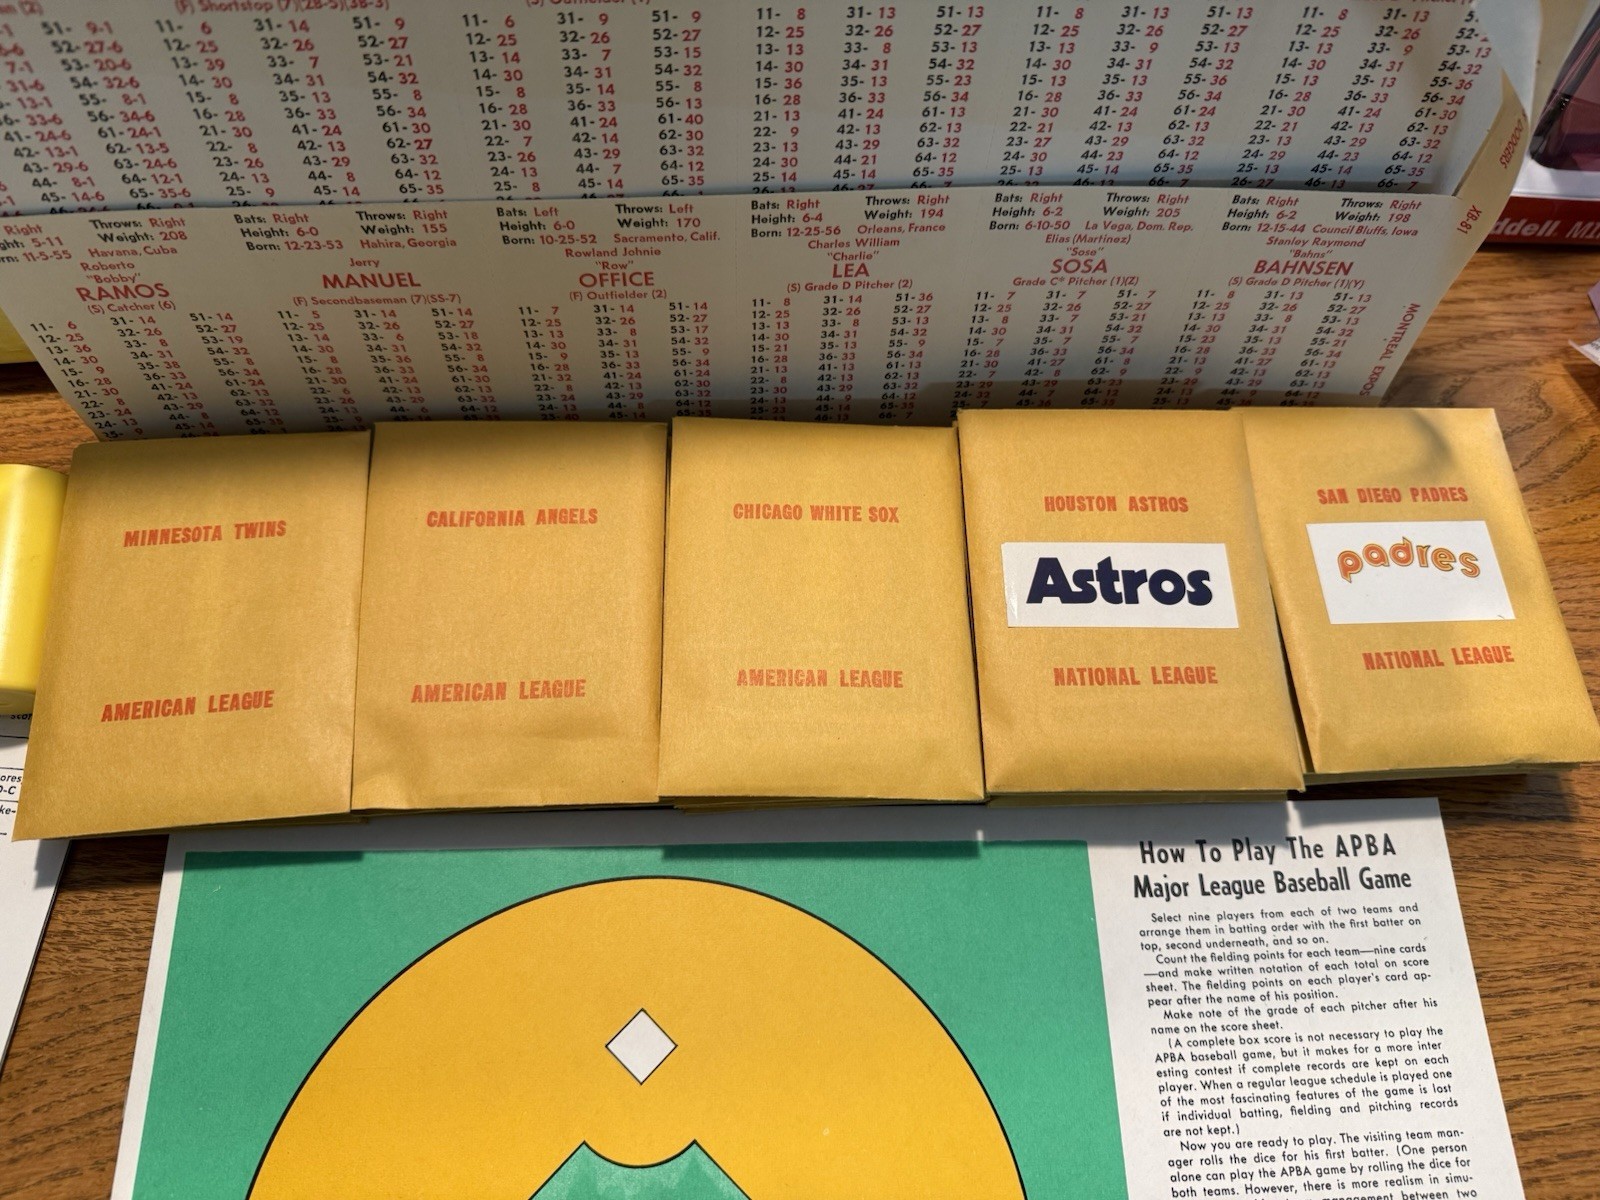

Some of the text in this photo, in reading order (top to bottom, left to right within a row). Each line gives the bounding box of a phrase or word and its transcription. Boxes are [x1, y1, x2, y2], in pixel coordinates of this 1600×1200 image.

[1499, 118, 1524, 169] DODGERS
[496, 206, 559, 217] Bats: Left
[614, 203, 694, 214] Throws: Left
[992, 206, 1063, 218] Height: 6-2
[1103, 206, 1181, 218] Weight: 205
[857, 222, 946, 234] Orleans, France
[1085, 220, 1193, 233] La Vega, Dom. Rep.
[1312, 224, 1419, 236] Council Bluffs, Iowa
[1565, 221, 1600, 239] MI
[359, 237, 457, 249] Hahira, Georgia
[613, 231, 720, 243] Sacramento, Calif.
[808, 237, 900, 249] Charles William
[1045, 233, 1131, 245] Elias (Martinez)
[1266, 236, 1366, 248] Stanley Raymond
[88, 245, 178, 258] Havana, Cuba
[565, 247, 661, 258] Rowland Johnie
[80, 261, 135, 271] Roberto
[350, 257, 380, 268] Jerry
[832, 262, 870, 278] LEA
[1050, 258, 1107, 274] SOSA
[1253, 259, 1354, 276] BAHNSEN
[86, 272, 141, 284] "Bobby"
[322, 272, 421, 289] MANUEL
[579, 271, 654, 288] OFFICE
[75, 283, 170, 302] RAMOS
[293, 294, 461, 307] (F) Secondbaseman (7)(SS-7)
[569, 289, 667, 301] (F) Outfielder (2)
[87, 300, 176, 315] (S) Catcher (6)
[1359, 303, 1421, 396] MONTREAL EXPOS
[1044, 495, 1189, 513] HOUSTON ASTROS
[1316, 486, 1469, 505] SAN DIEGO PADRES
[426, 508, 598, 528] CALIFORNIA ANGELS
[733, 503, 899, 523] CHICAGO WHITE SOX
[123, 520, 287, 548] MINNESOTA TWINS
[1337, 536, 1481, 584] padres
[1026, 556, 1213, 606] Astros
[1362, 645, 1515, 671] NATIONAL LEAGUE
[737, 669, 904, 689] AMERICAN LEAGUE
[1053, 666, 1219, 686] NATIONAL LEAGUE
[411, 679, 586, 703] AMERICAN LEAGUE
[101, 690, 275, 723] AMERICAN LEAGUE
[1140, 833, 1397, 865] How To Play The APBA
[1133, 866, 1412, 903] Major League Baseball Game
[1151, 912, 1181, 923] Select
[1216, 910, 1255, 923] players
[1260, 909, 1284, 919] from
[1290, 907, 1315, 918] each
[1320, 906, 1332, 916] of
[1337, 907, 1357, 915] two
[1363, 906, 1393, 914] teams
[1399, 902, 1419, 913] and
[1139, 929, 1181, 938] arrange
[1185, 925, 1211, 935] them
[1228, 923, 1267, 935] batting
[1271, 922, 1298, 932] order
[1302, 920, 1325, 930] with
[1329, 919, 1346, 929] the
[1349, 918, 1368, 928] first
[1372, 918, 1404, 927] batter
[1408, 918, 1421, 926] on
[1140, 935, 1329, 953] top, second underneath, and so on.
[1151, 1020, 1283, 1035] name on the score sheet.
[1155, 1052, 1186, 1063] APBA
[1190, 1049, 1237, 1062] baseball
[1242, 1051, 1276, 1062] game,
[1280, 1047, 1298, 1058] but
[1302, 1046, 1310, 1056] it
[1315, 1045, 1349, 1056] makes
[1353, 1043, 1369, 1054] for
[1386, 1044, 1413, 1052] more
[1418, 1041, 1442, 1051] inter
[1180, 1130, 1464, 1153] Now you are ready to play. The visiting team man-
